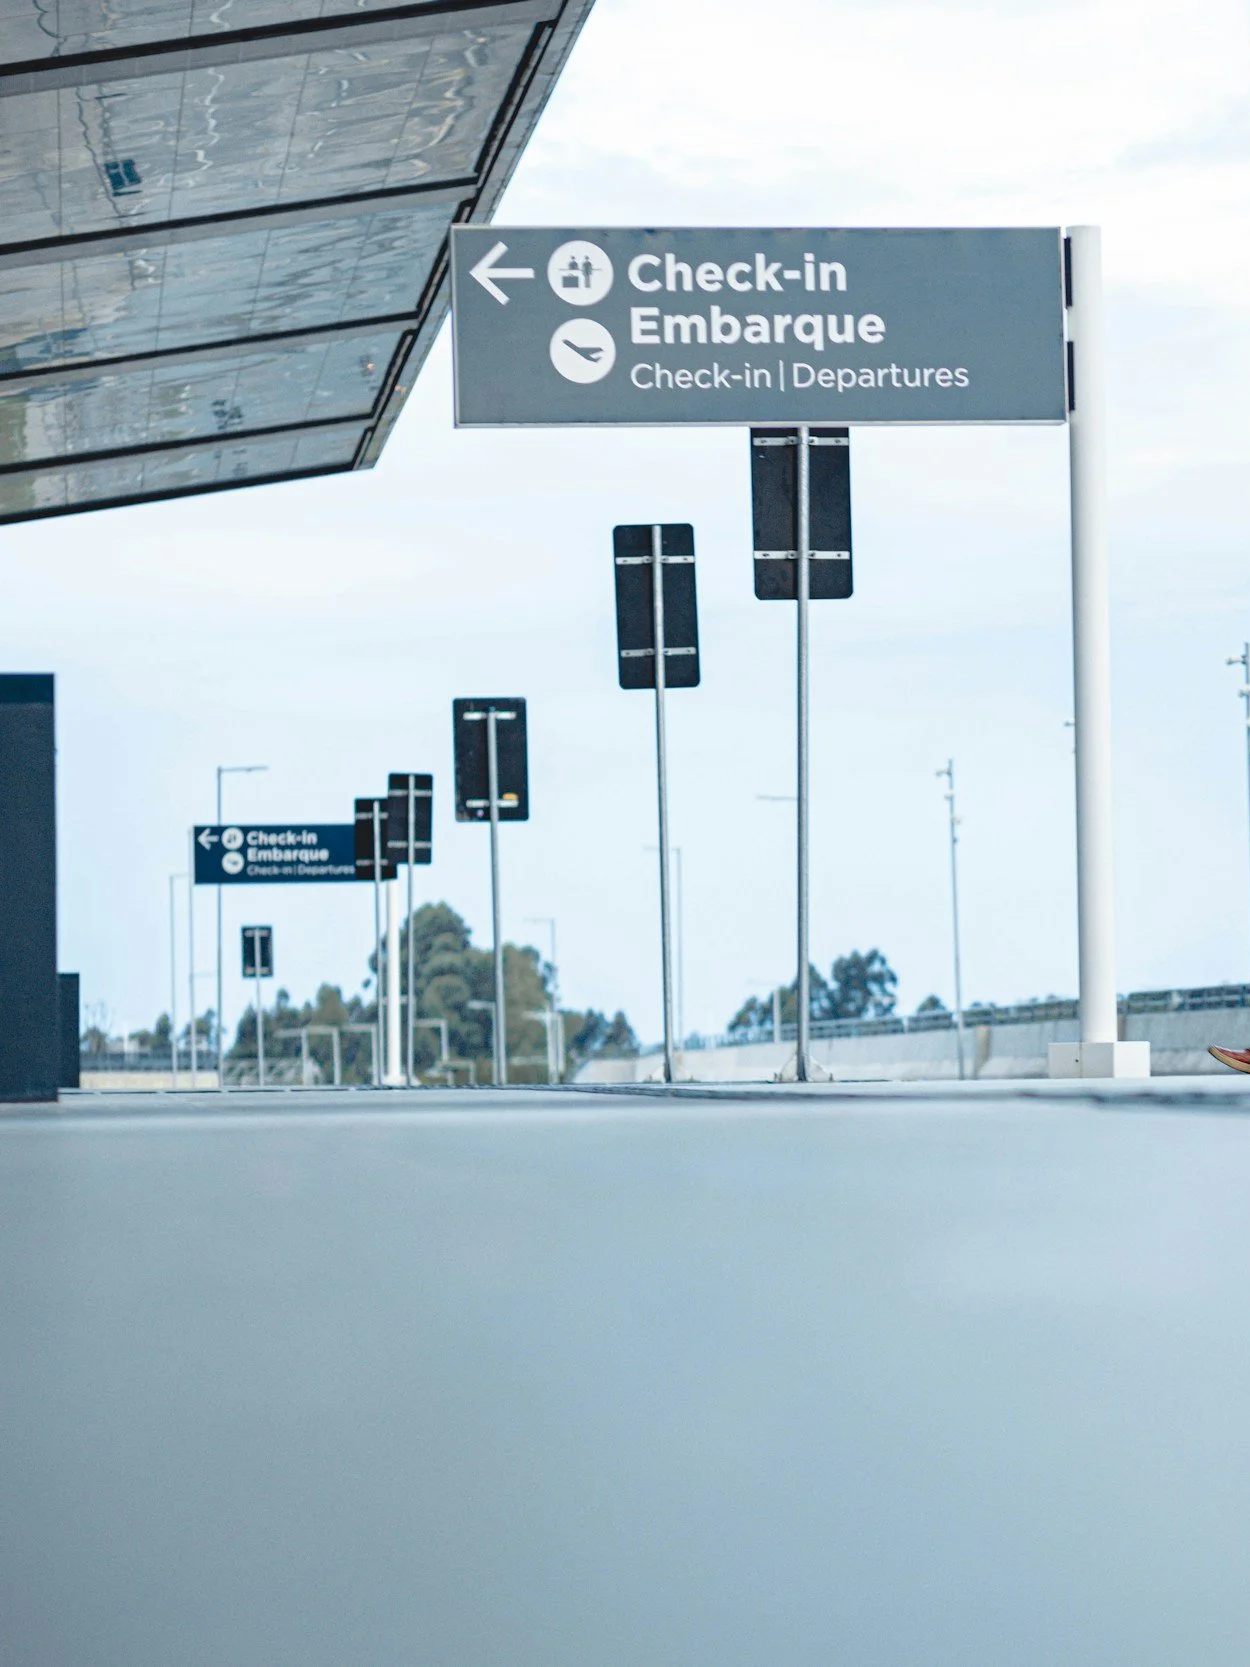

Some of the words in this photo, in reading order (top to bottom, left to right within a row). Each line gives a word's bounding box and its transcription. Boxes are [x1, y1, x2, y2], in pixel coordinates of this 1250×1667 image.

[629, 253, 847, 292] Check-in
[631, 305, 886, 351] Embarque
[631, 362, 771, 389] Check-in
[793, 362, 969, 393] Departures
[246, 829, 318, 846] Check-in
[246, 847, 329, 863] Embarque
[246, 864, 293, 876] Check-in
[298, 864, 356, 876] Departures
